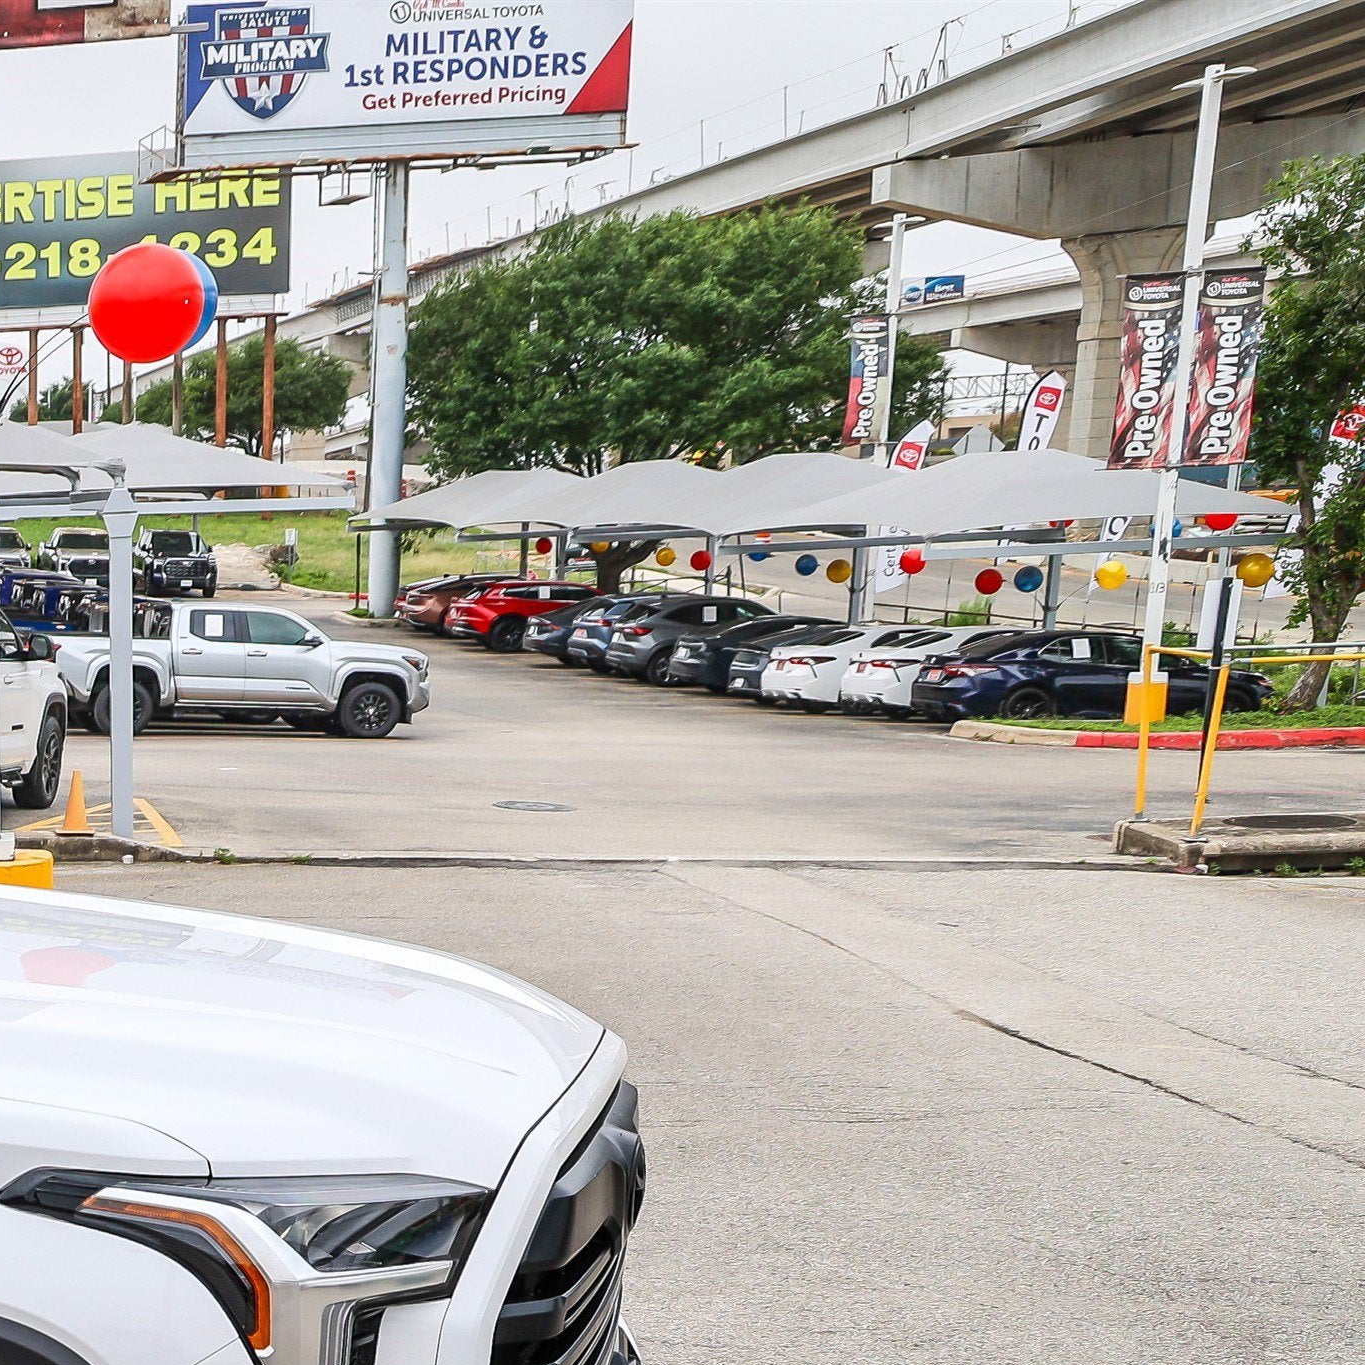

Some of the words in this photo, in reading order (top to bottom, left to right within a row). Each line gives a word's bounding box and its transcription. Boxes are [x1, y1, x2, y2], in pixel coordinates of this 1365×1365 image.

[239, 15, 290, 29] SALUTE
[412, 8, 490, 23] UNIVERSAL
[492, 4, 544, 18] TOYOTA
[207, 36, 324, 66] MILITARY
[385, 25, 523, 58] MILITARY
[528, 24, 548, 50] &
[344, 64, 385, 88] 1st
[392, 51, 587, 85] RESPONDERS
[362, 94, 396, 110] Get
[402, 87, 492, 109] Preferred
[498, 84, 566, 105] Pricing
[1142, 284, 1182, 293] UNIVERSAL
[1221, 280, 1261, 289] UNIVERSAL
